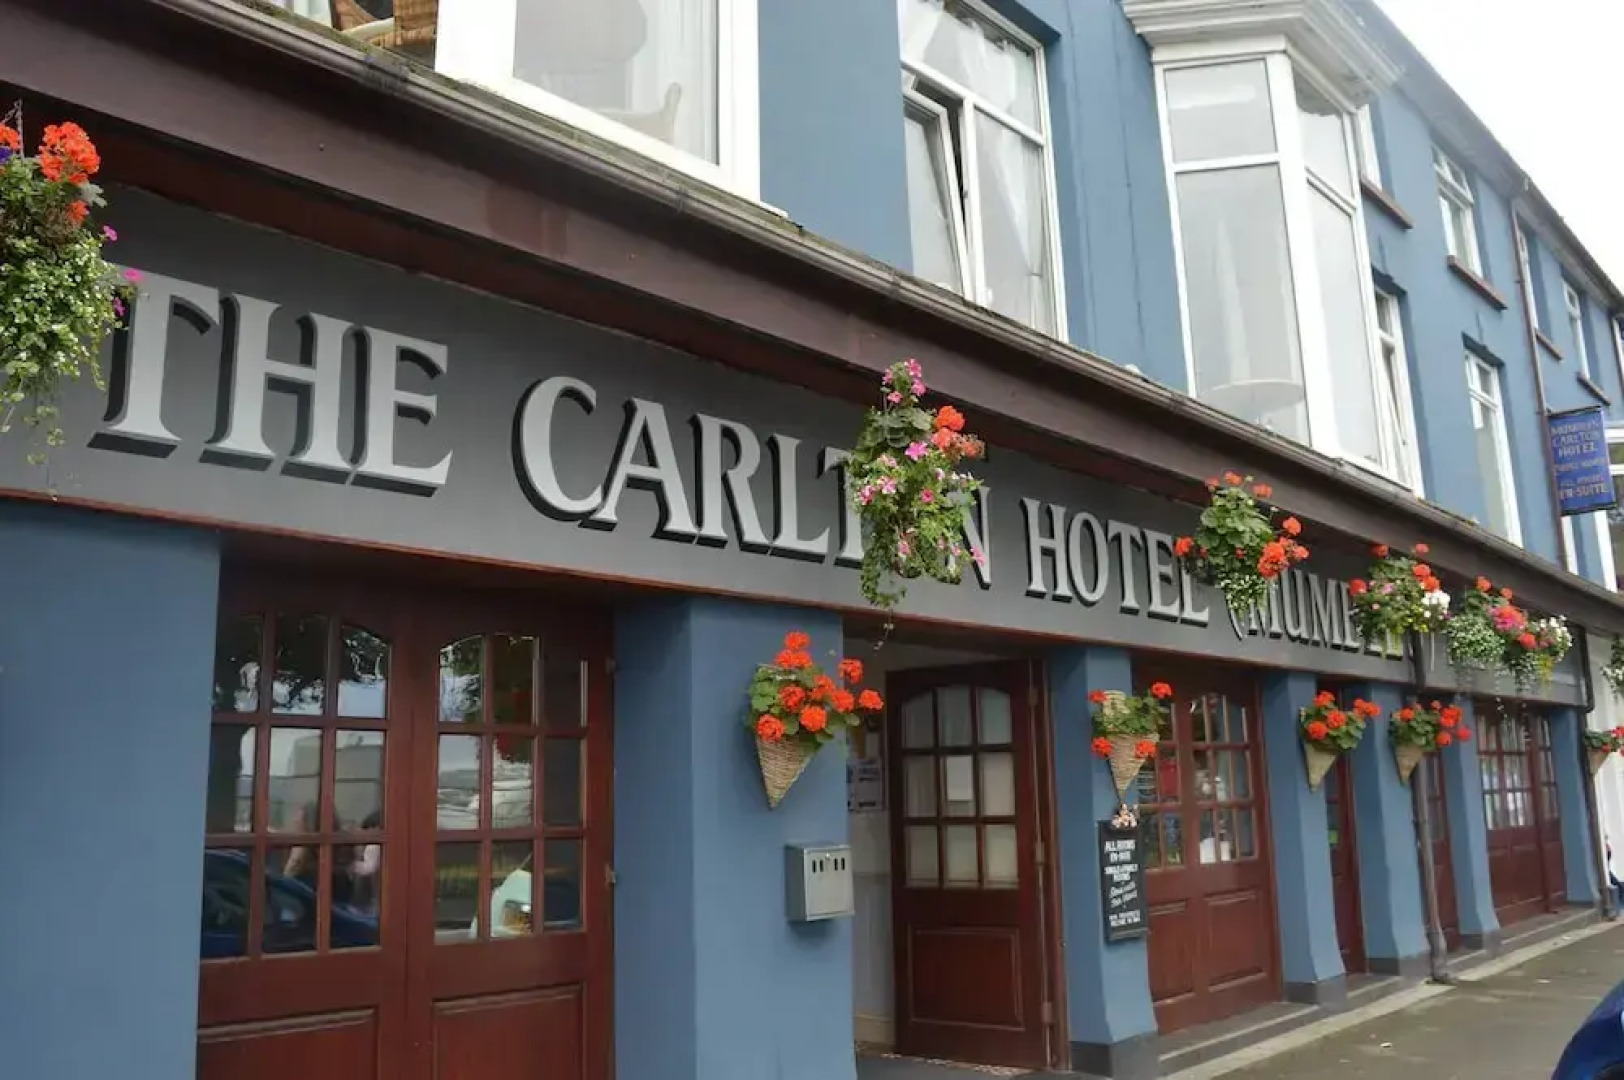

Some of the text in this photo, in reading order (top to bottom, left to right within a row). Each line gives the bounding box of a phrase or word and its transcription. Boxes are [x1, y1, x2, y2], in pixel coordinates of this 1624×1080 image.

[102, 260, 453, 488] THE
[515, 376, 990, 587] CARLTN
[1021, 497, 1209, 626] HOTEL
